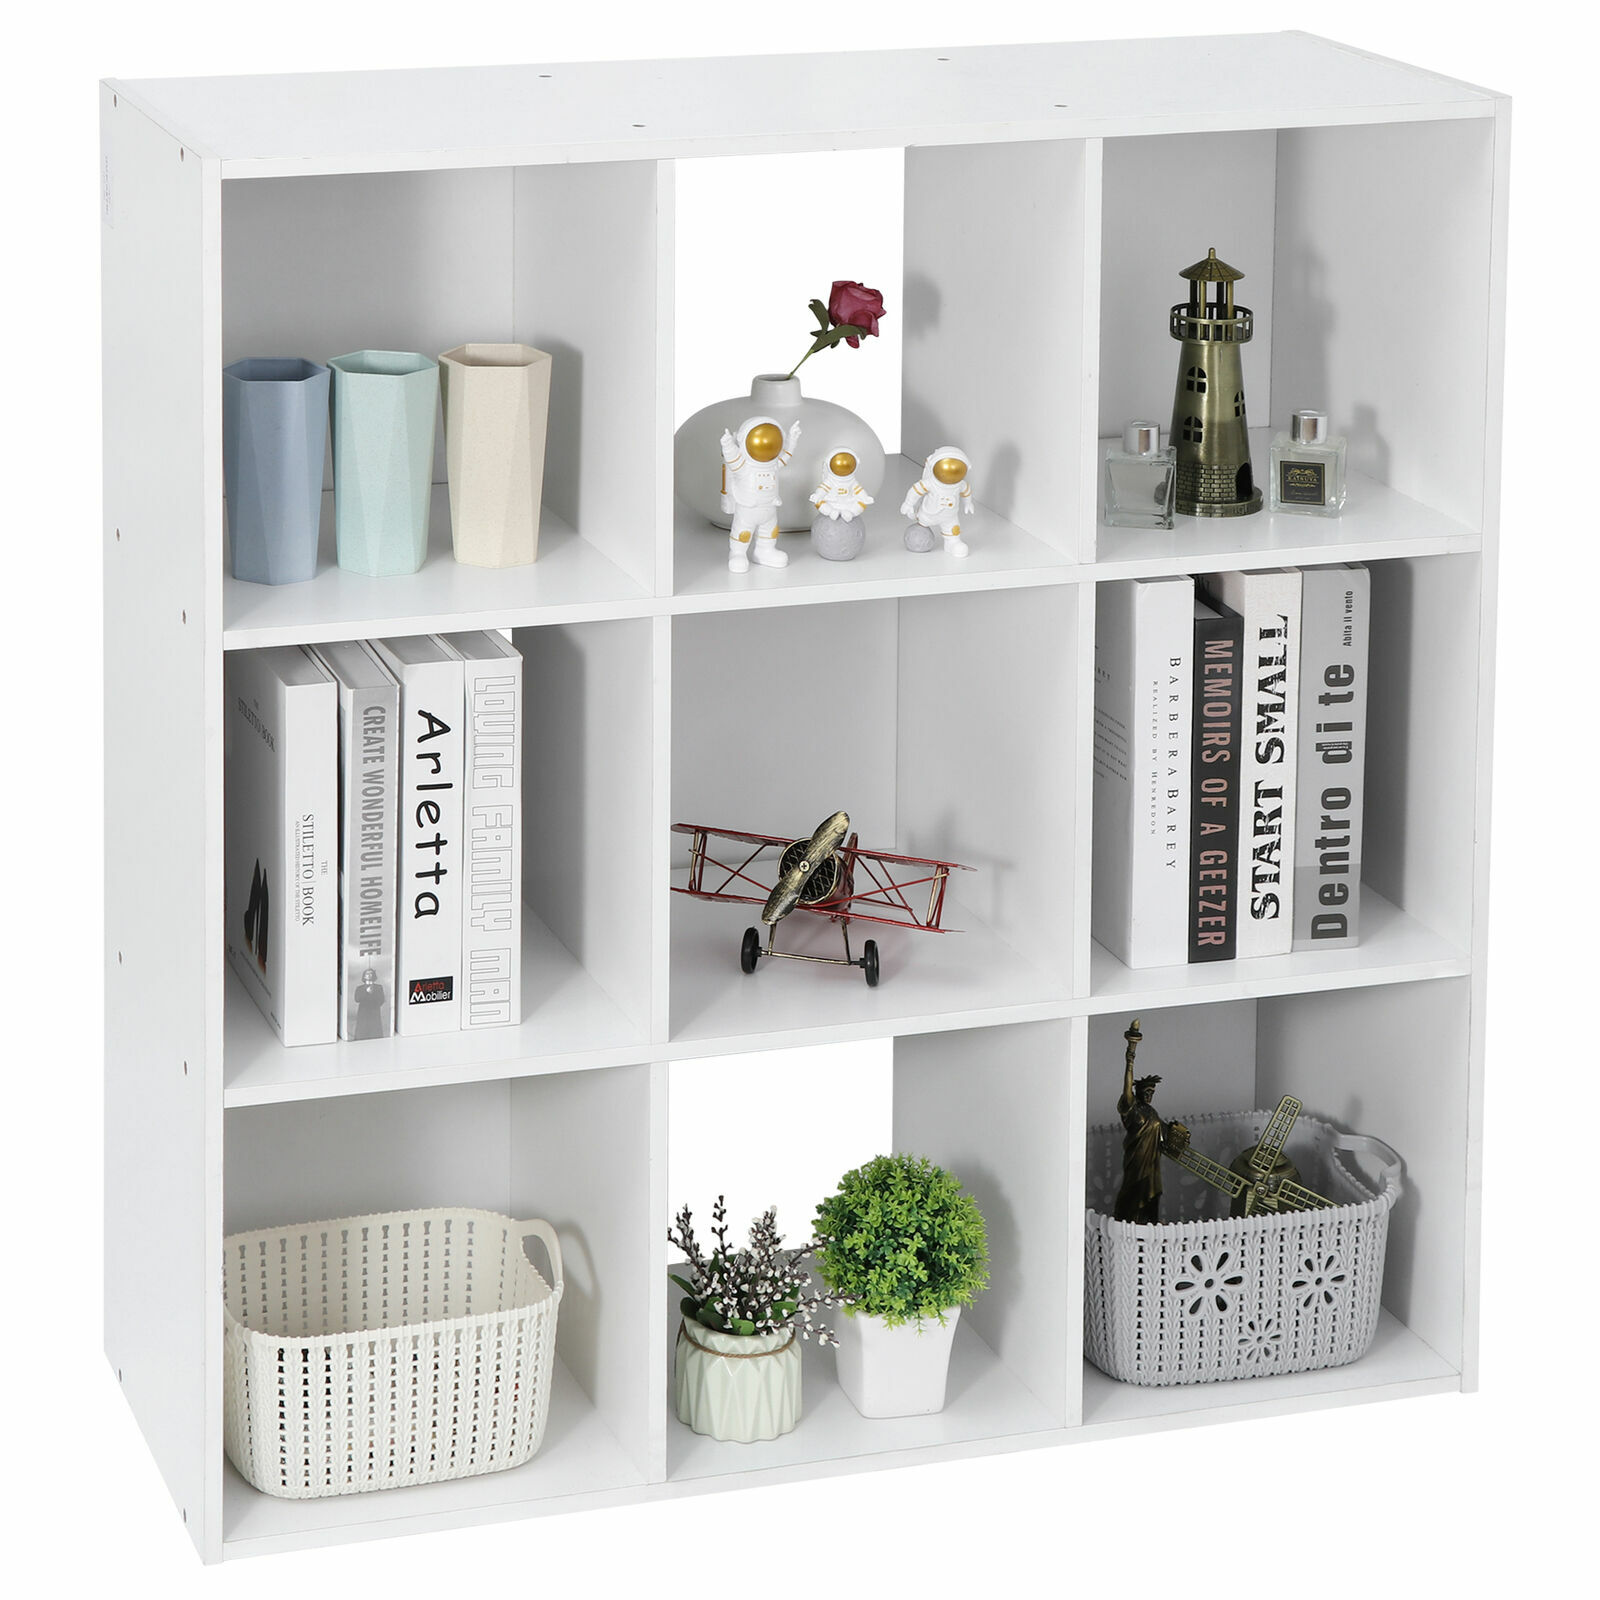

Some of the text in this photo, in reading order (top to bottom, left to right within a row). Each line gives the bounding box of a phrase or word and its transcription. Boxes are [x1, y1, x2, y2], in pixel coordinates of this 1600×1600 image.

[1344, 590, 1353, 613] vento
[1151, 749, 1158, 762] BY
[1318, 664, 1355, 706] te
[359, 705, 386, 958] CREATE WONDERFUL HOMELIFE
[414, 709, 453, 919] Arletta
[1150, 771, 1158, 836] HENREDON
[1197, 639, 1234, 947] MEMOIRS OF A GEEZER
[1250, 614, 1289, 920] START SMALL
[302, 813, 315, 926] STILETTO BOOK
[469, 675, 516, 1026] LOVING FAMILY MAN
[1311, 786, 1352, 940] Dentro
